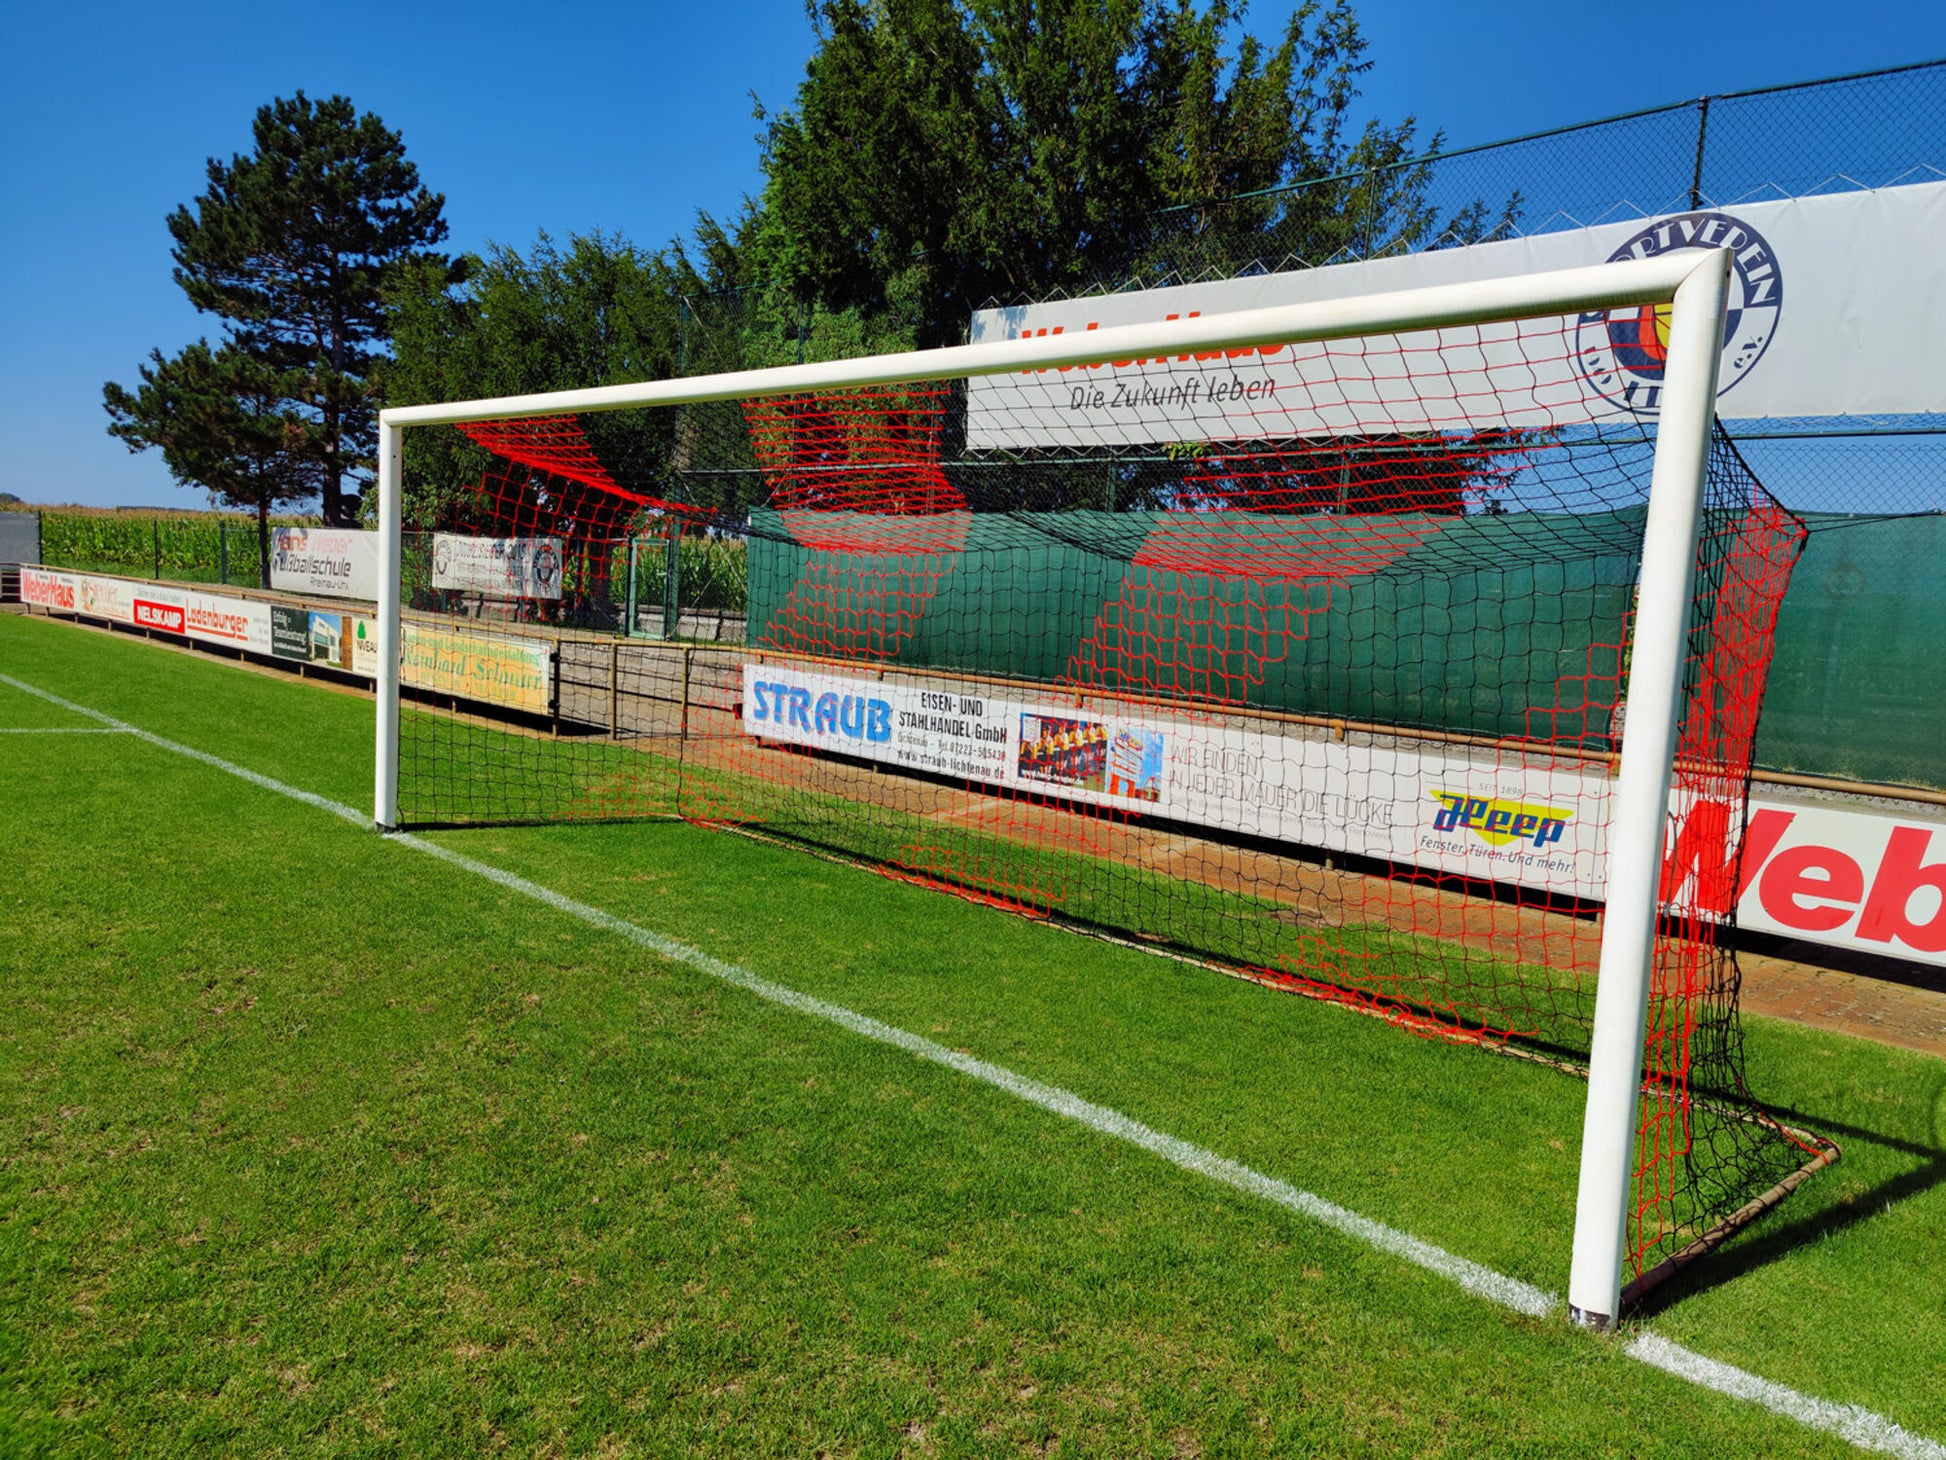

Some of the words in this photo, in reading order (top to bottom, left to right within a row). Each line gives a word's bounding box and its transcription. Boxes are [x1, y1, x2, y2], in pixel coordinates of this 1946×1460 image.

[1070, 387, 1105, 410] Die
[1110, 377, 1201, 411] Zukunft
[1206, 376, 1276, 403] leben
[23, 571, 75, 609] WeberHaus
[137, 605, 182, 628] NELSKAMP
[753, 680, 892, 743] STRAUB
[960, 698, 983, 716] UND
[899, 711, 971, 738] STAHLHANDEL
[975, 723, 1008, 744] GmbH
[1172, 745, 1202, 769] WIR
[1204, 749, 1258, 776] FINDEN
[1303, 791, 1328, 816] DIE
[1501, 786, 1524, 796] 1898
